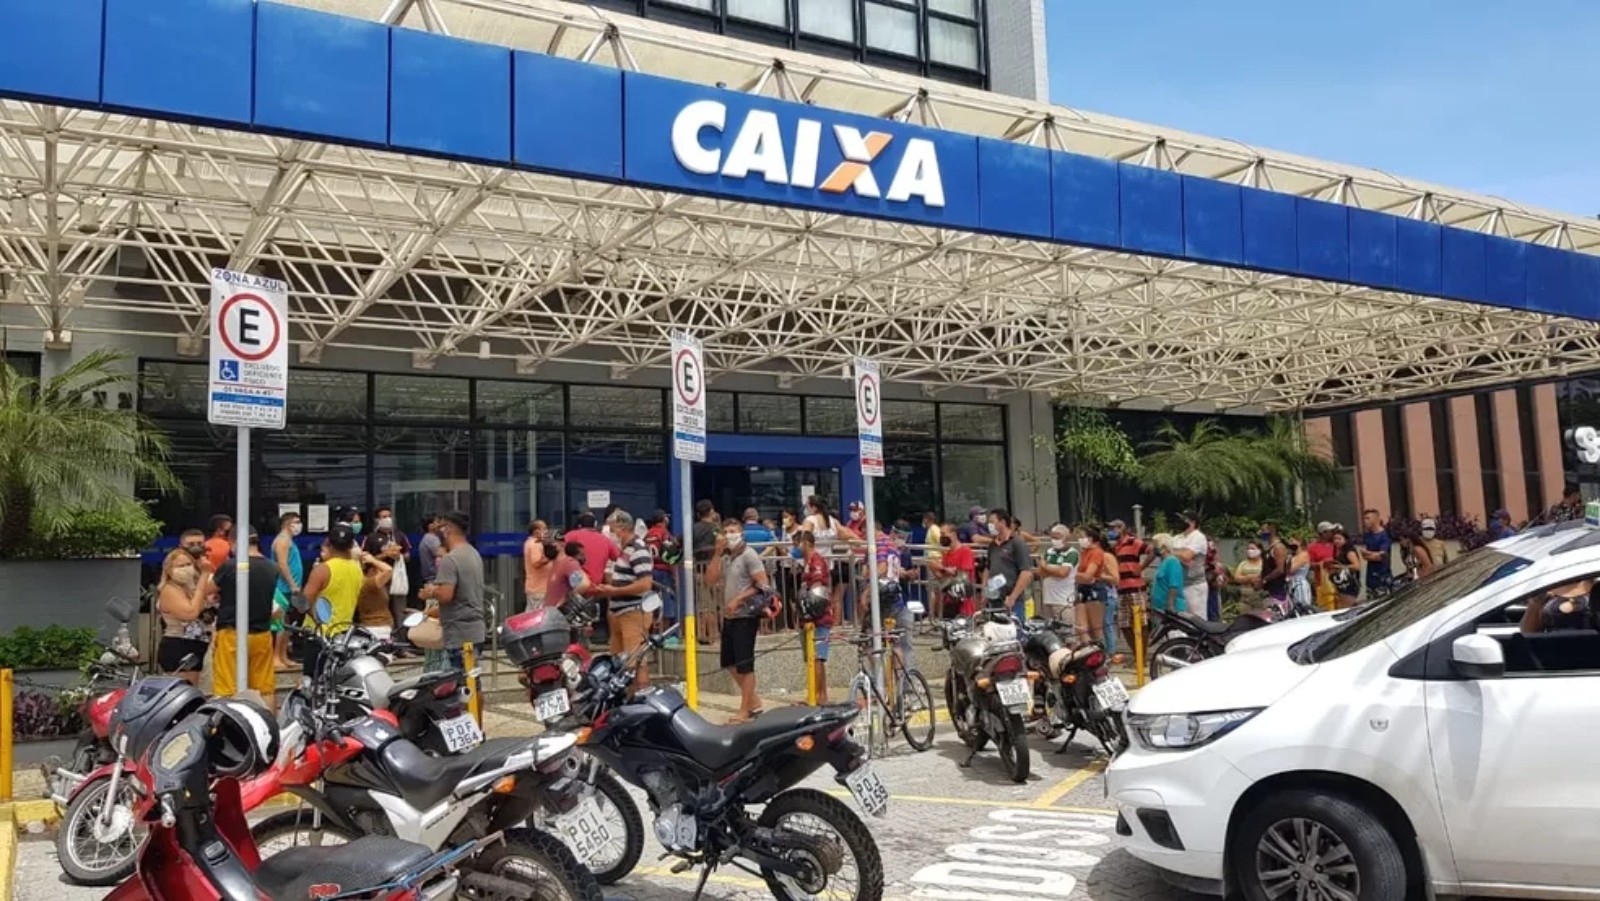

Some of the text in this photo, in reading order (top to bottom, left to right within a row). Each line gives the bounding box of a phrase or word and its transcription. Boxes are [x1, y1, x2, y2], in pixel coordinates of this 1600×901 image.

[671, 99, 946, 208] CAIXA
[214, 269, 250, 285] ZONA
[253, 277, 285, 293] AZUL
[239, 307, 261, 346] E
[683, 361, 694, 393] E
[864, 385, 872, 415] E
[446, 721, 472, 739] POF
[857, 771, 880, 798] POJ
[863, 785, 889, 812] 5159
[576, 825, 610, 858] 5460
